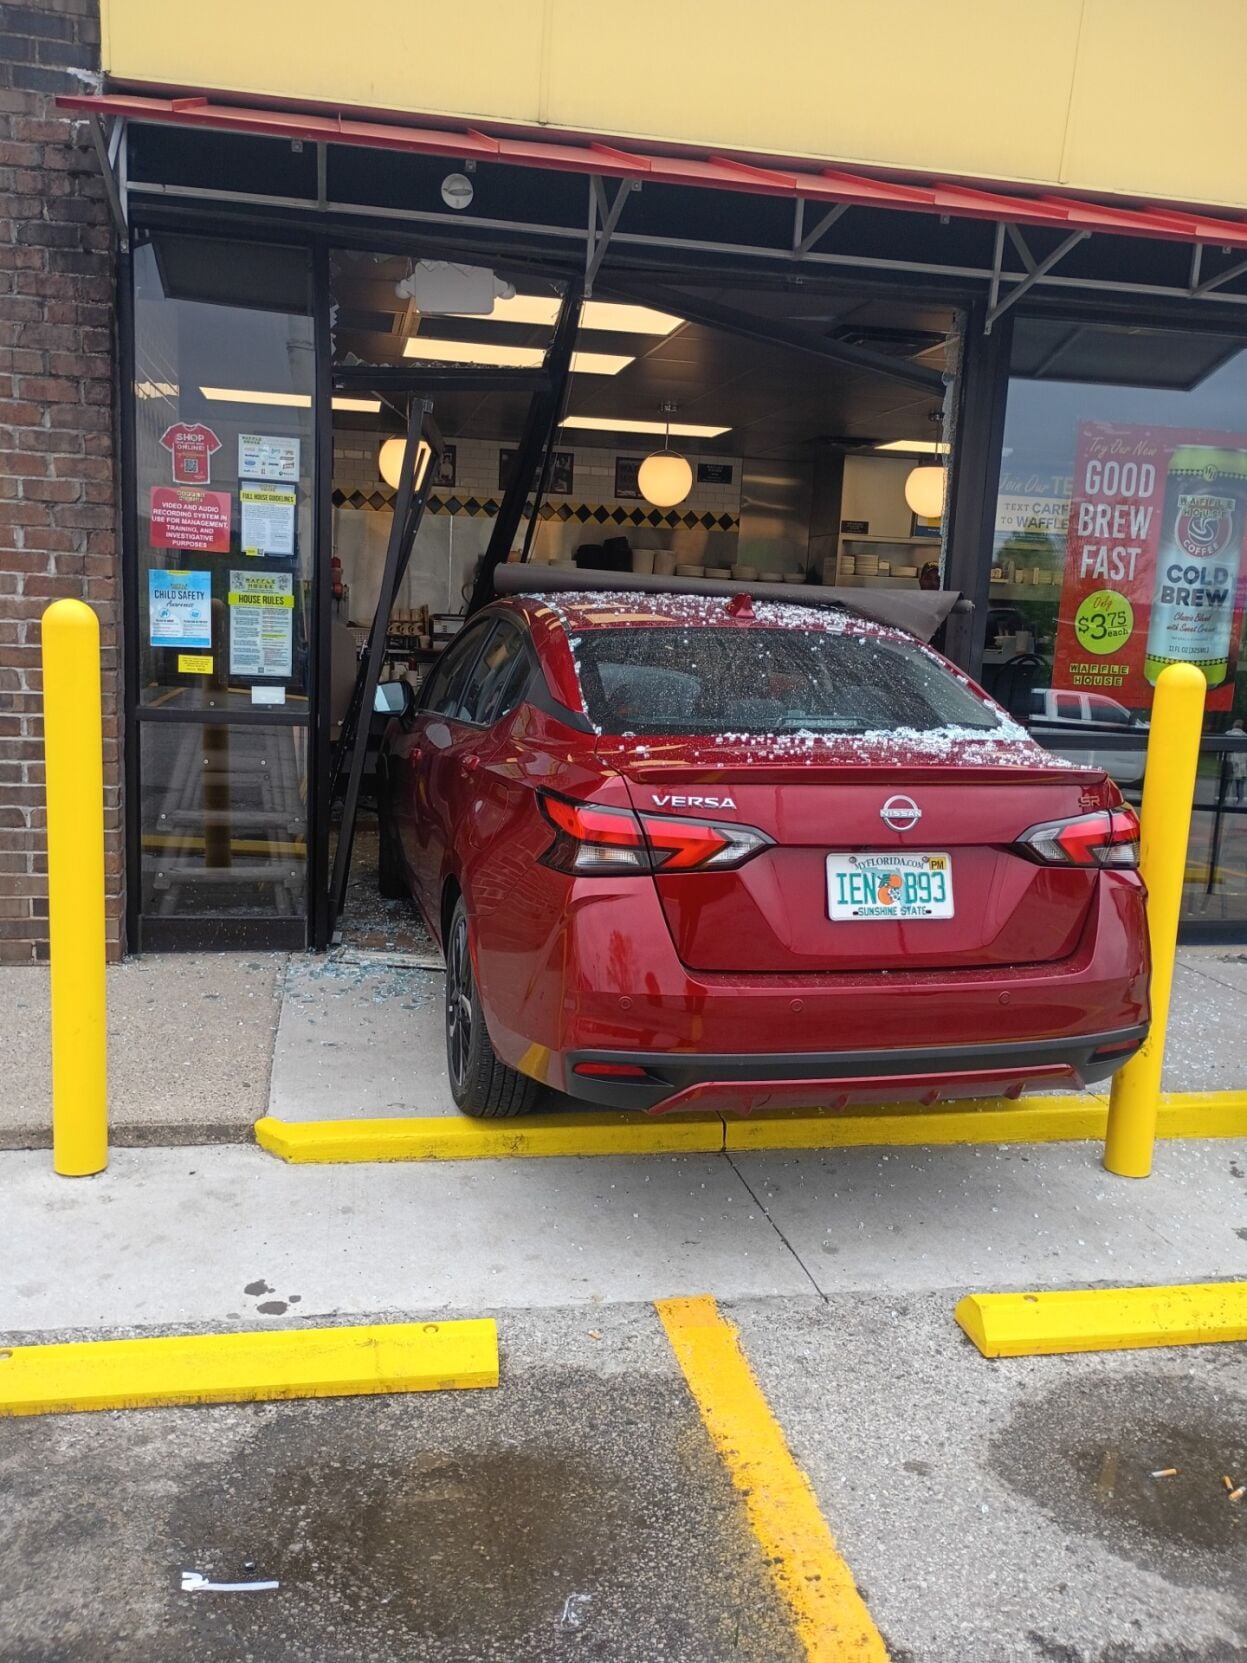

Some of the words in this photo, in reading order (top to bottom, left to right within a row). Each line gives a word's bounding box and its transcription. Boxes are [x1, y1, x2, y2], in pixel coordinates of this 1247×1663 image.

[176, 433, 204, 442] SHOP
[1090, 437, 1108, 458] Try
[1110, 439, 1132, 454] Our
[1133, 441, 1158, 457] New
[1024, 474, 1050, 493] Our
[1085, 460, 1156, 498] GOOD
[1005, 502, 1030, 511] TEXT
[153, 508, 192, 518] RECORDING
[1000, 516, 1013, 524] TO
[1016, 516, 1069, 530] WAFFLE
[1078, 503, 1154, 540] BREW
[166, 532, 214, 542] INVESTIGATIVE
[172, 540, 208, 548] PURPOSES
[1183, 540, 1219, 556] COFFEE
[1080, 545, 1142, 581] FAST
[1166, 564, 1228, 586] COLD
[154, 590, 176, 600] CHILD
[178, 591, 205, 601] SAFETY
[238, 594, 261, 604] HOUSE
[262, 595, 284, 606] RULES
[1160, 585, 1229, 607] BREW
[1094, 596, 1112, 612] Only
[1108, 628, 1128, 638] each
[1070, 664, 1128, 674] WAFFLE
[1074, 676, 1122, 686] HOUSE
[652, 794, 737, 810] VERSA
[1080, 796, 1100, 808] SR
[881, 809, 922, 818] NISSAN
[854, 856, 924, 870] MYFLORIDA.COM
[930, 860, 944, 870] PM
[836, 872, 877, 904] IEN
[904, 872, 946, 904] B93
[858, 906, 898, 916] SUNSHINE
[900, 906, 927, 916] STATE
